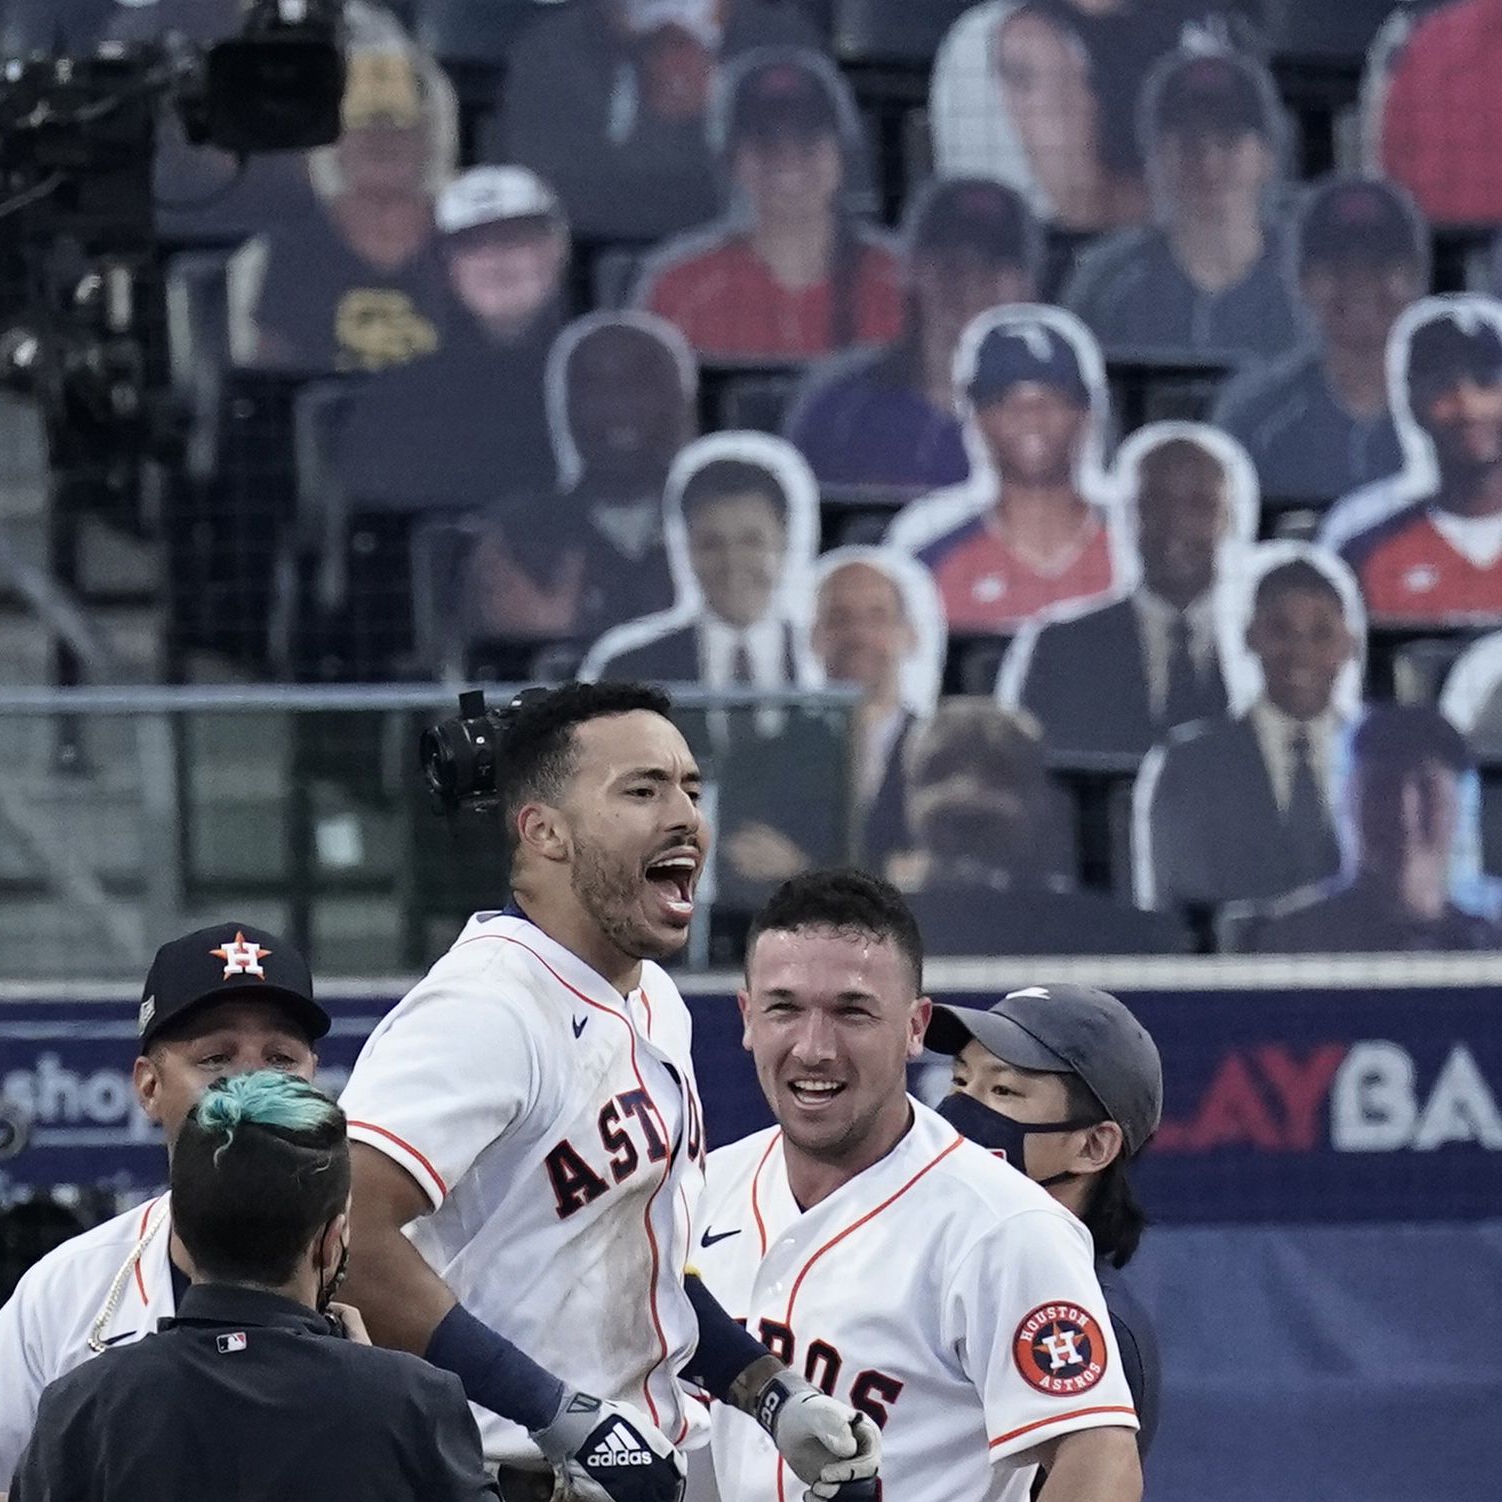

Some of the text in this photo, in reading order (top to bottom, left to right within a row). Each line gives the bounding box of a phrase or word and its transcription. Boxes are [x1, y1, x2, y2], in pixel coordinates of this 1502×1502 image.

[219, 942, 264, 975] H
[1019, 1303, 1090, 1344] HOUSTON
[1042, 1330, 1084, 1369] H
[1038, 1362, 1102, 1393] ASTROS
[587, 1450, 653, 1468] adidas
